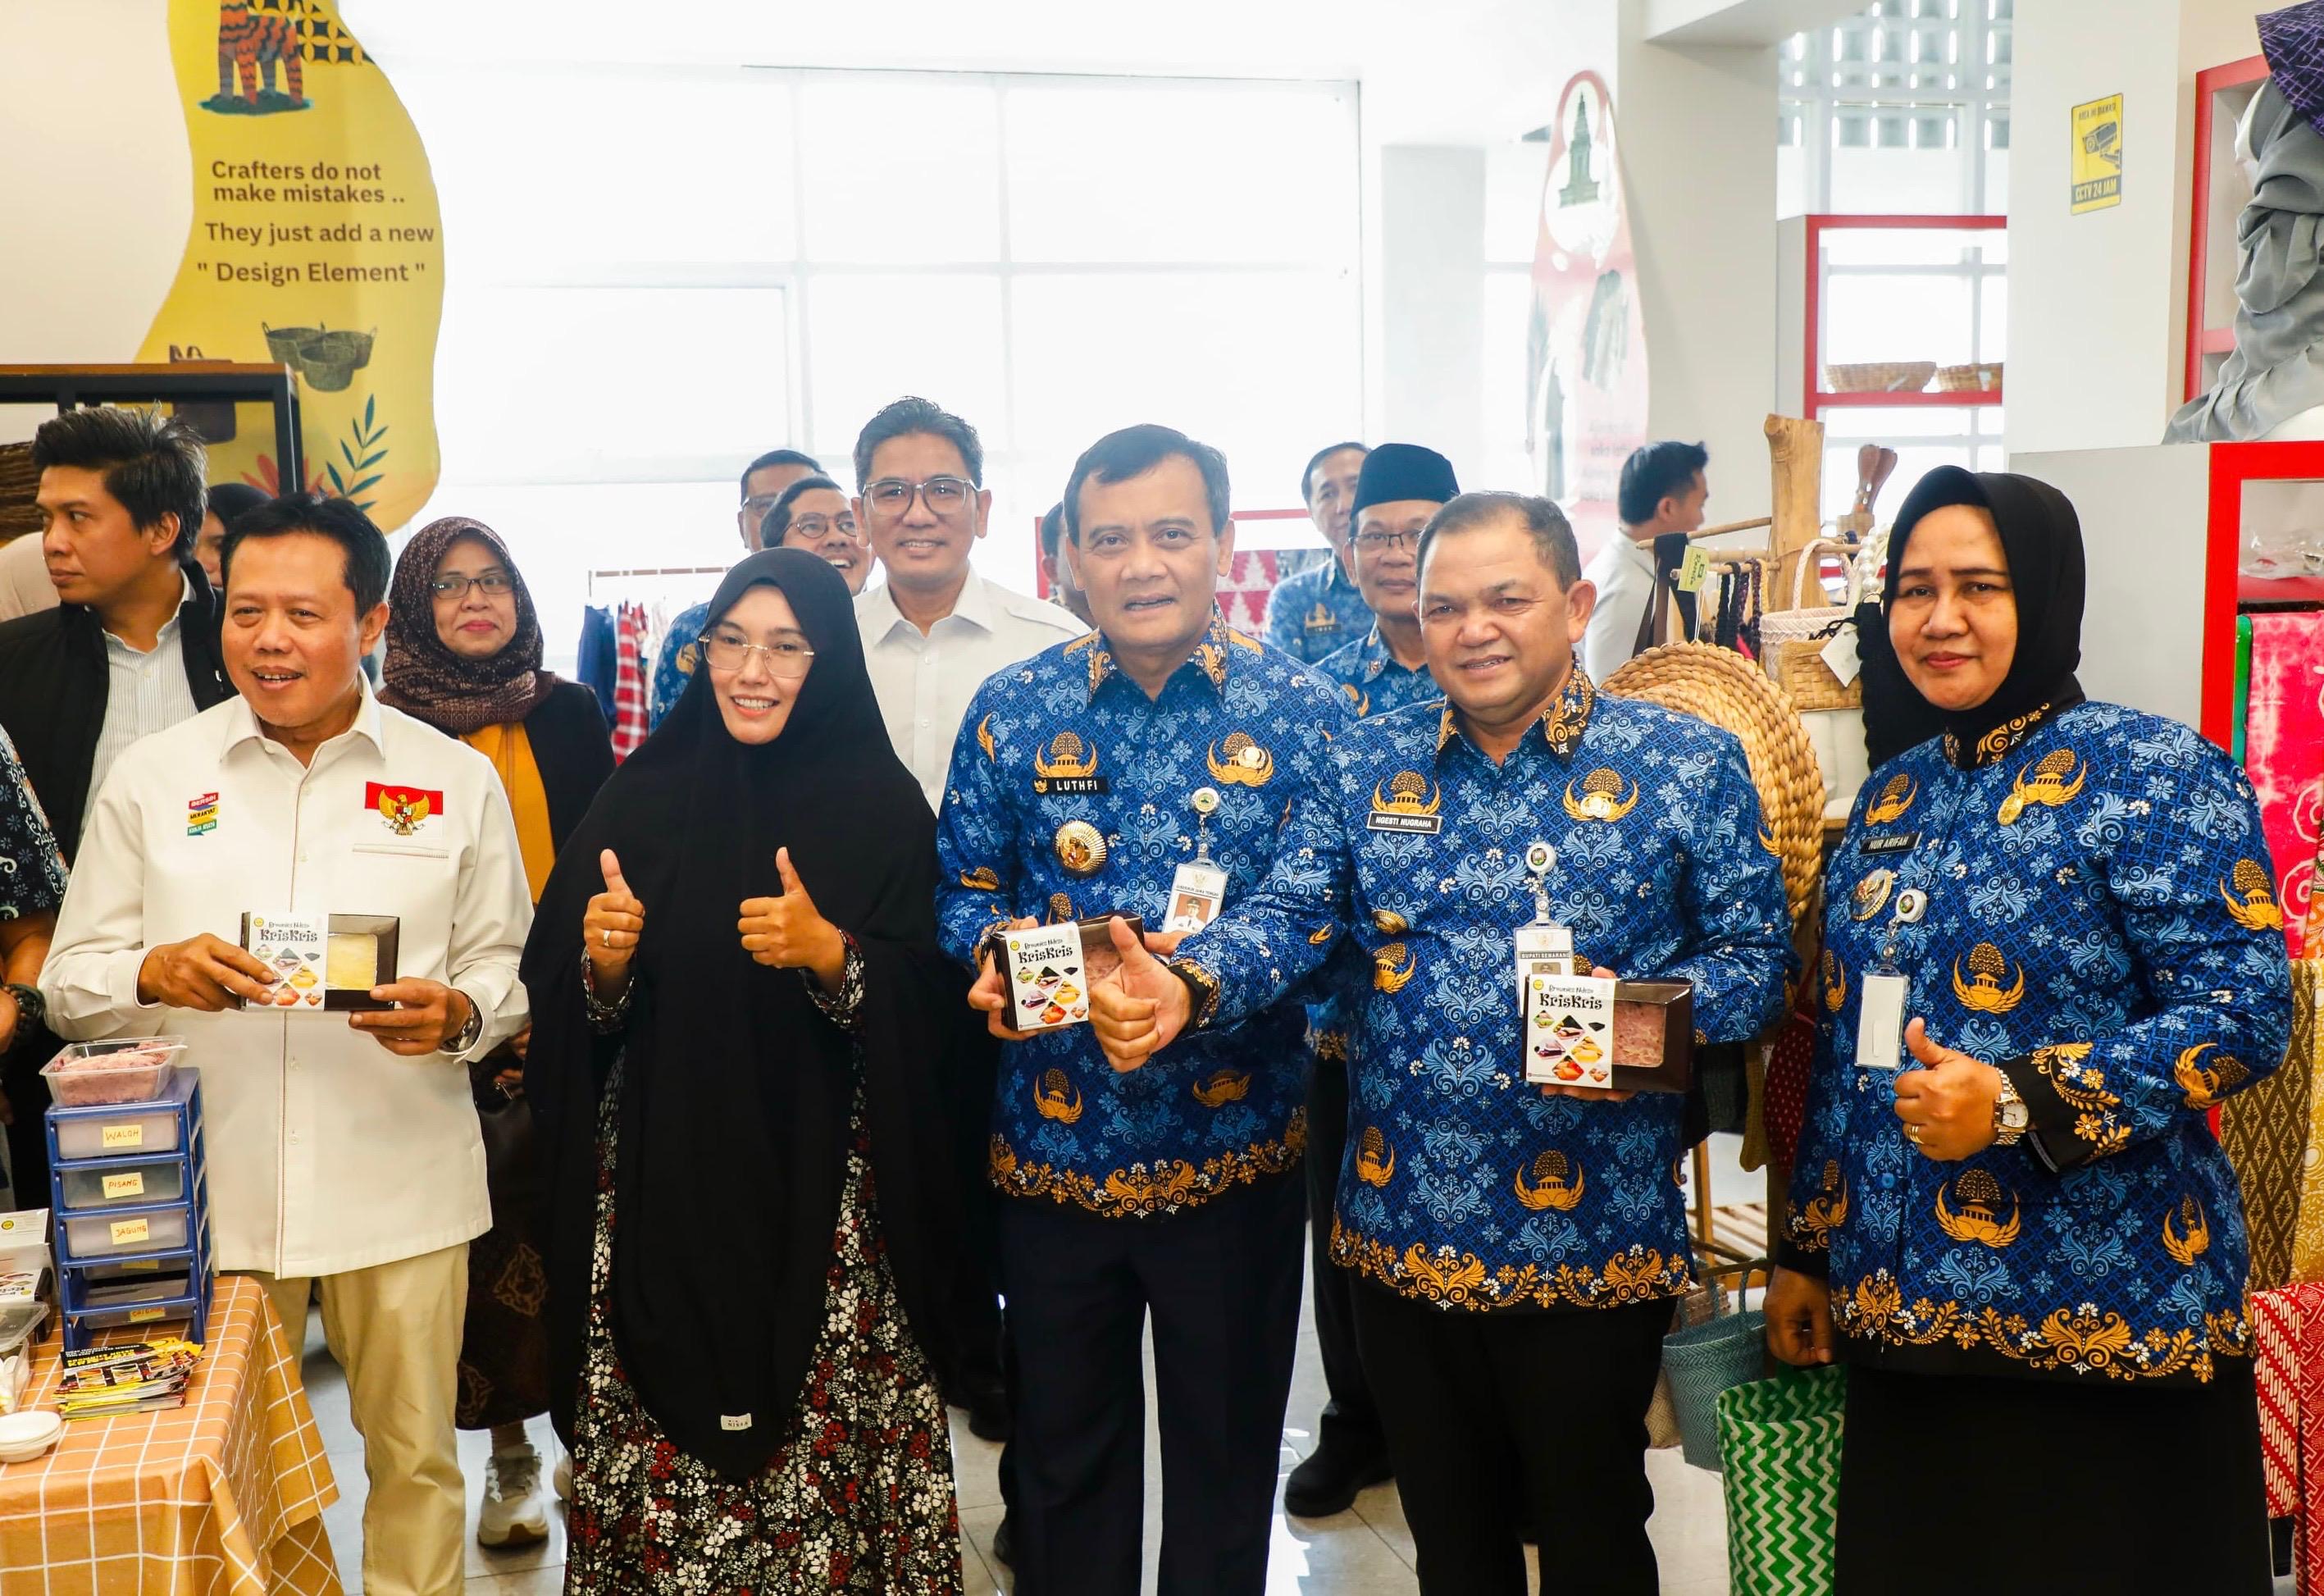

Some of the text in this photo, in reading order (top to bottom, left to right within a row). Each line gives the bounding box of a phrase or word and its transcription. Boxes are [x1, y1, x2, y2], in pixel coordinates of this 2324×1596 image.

[212, 161, 381, 180] Crafters do not
[214, 184, 276, 202] make
[284, 185, 385, 203] mistakes
[2075, 177, 2117, 202] CCTV 24 JAM
[205, 222, 435, 245] They just add a new
[216, 262, 300, 287] Design
[308, 262, 409, 282] Element
[1056, 780, 1097, 791] LUTHFI
[1375, 816, 1432, 828] NGESTI NUGRAHA
[1868, 836, 1910, 850] NUR ARIFAH
[260, 928, 318, 942] KrisKris
[1018, 945, 1073, 964] KrisKris
[1539, 992, 1602, 1010] KrisKris
